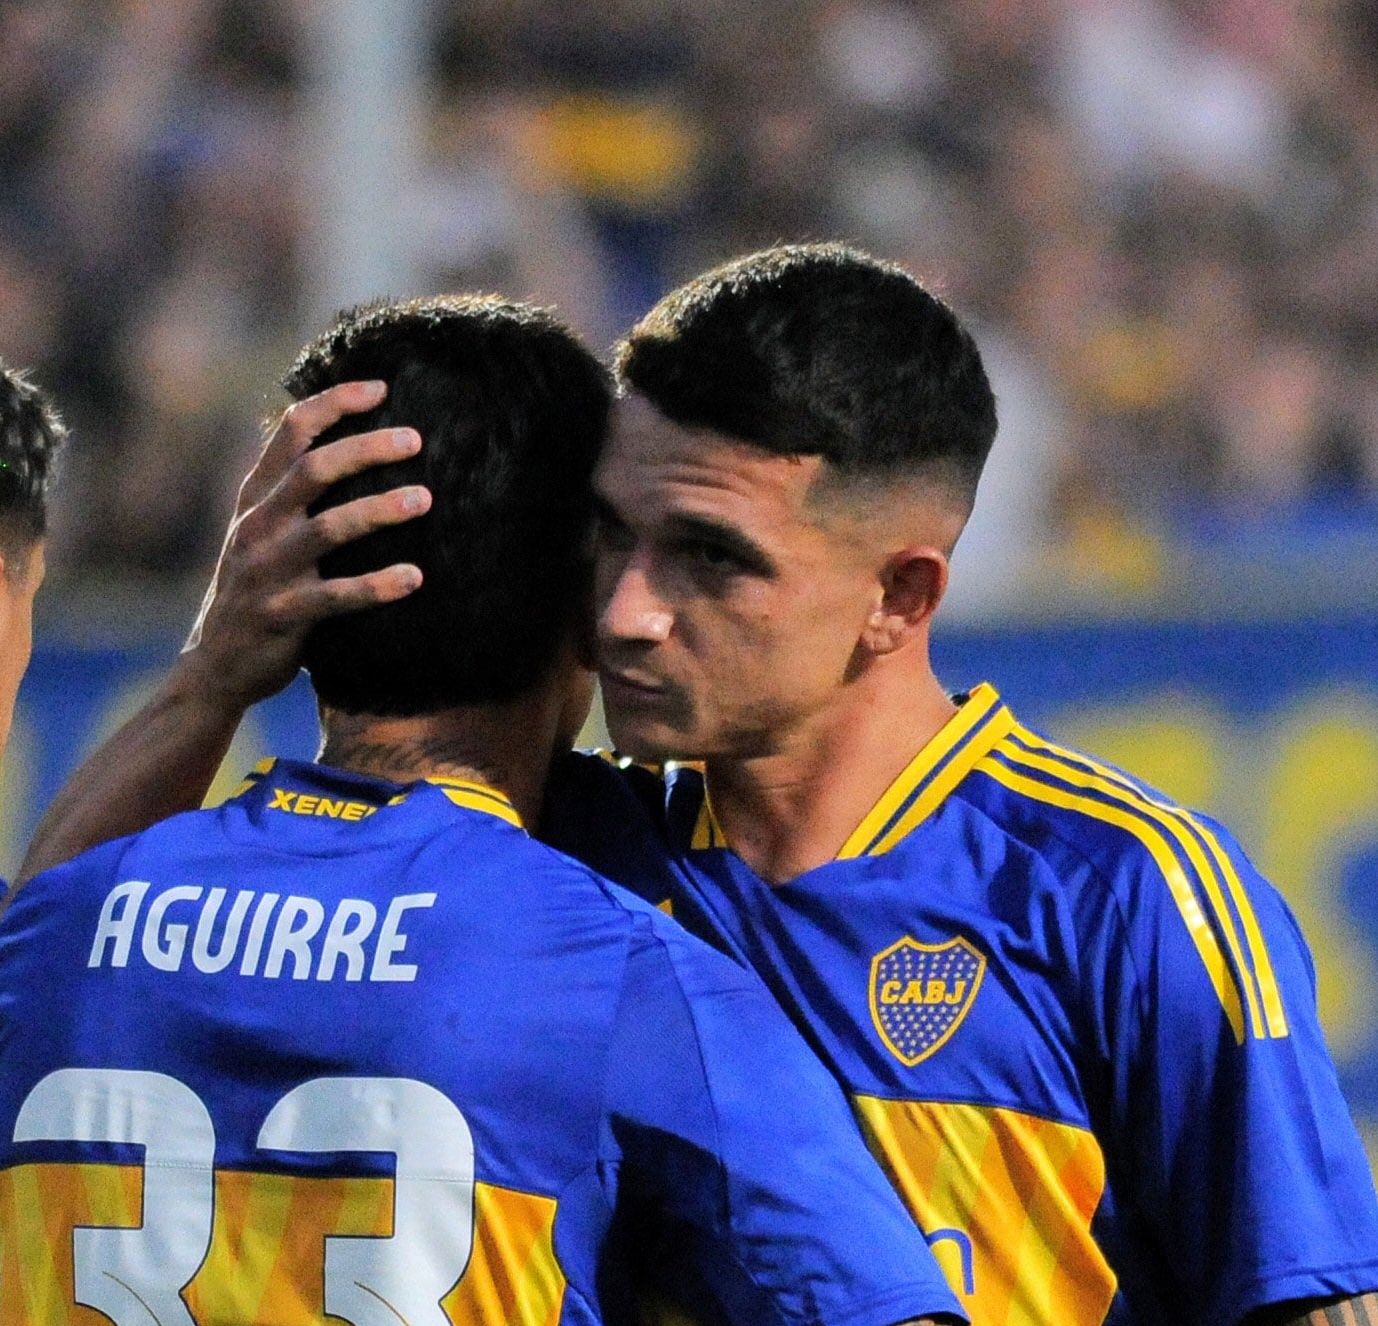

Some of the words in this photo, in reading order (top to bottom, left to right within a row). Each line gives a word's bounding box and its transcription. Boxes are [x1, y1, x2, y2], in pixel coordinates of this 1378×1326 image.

[268, 788, 378, 821] XENE
[87, 881, 437, 982] AGUIRRE
[880, 979, 966, 1005] CABJ
